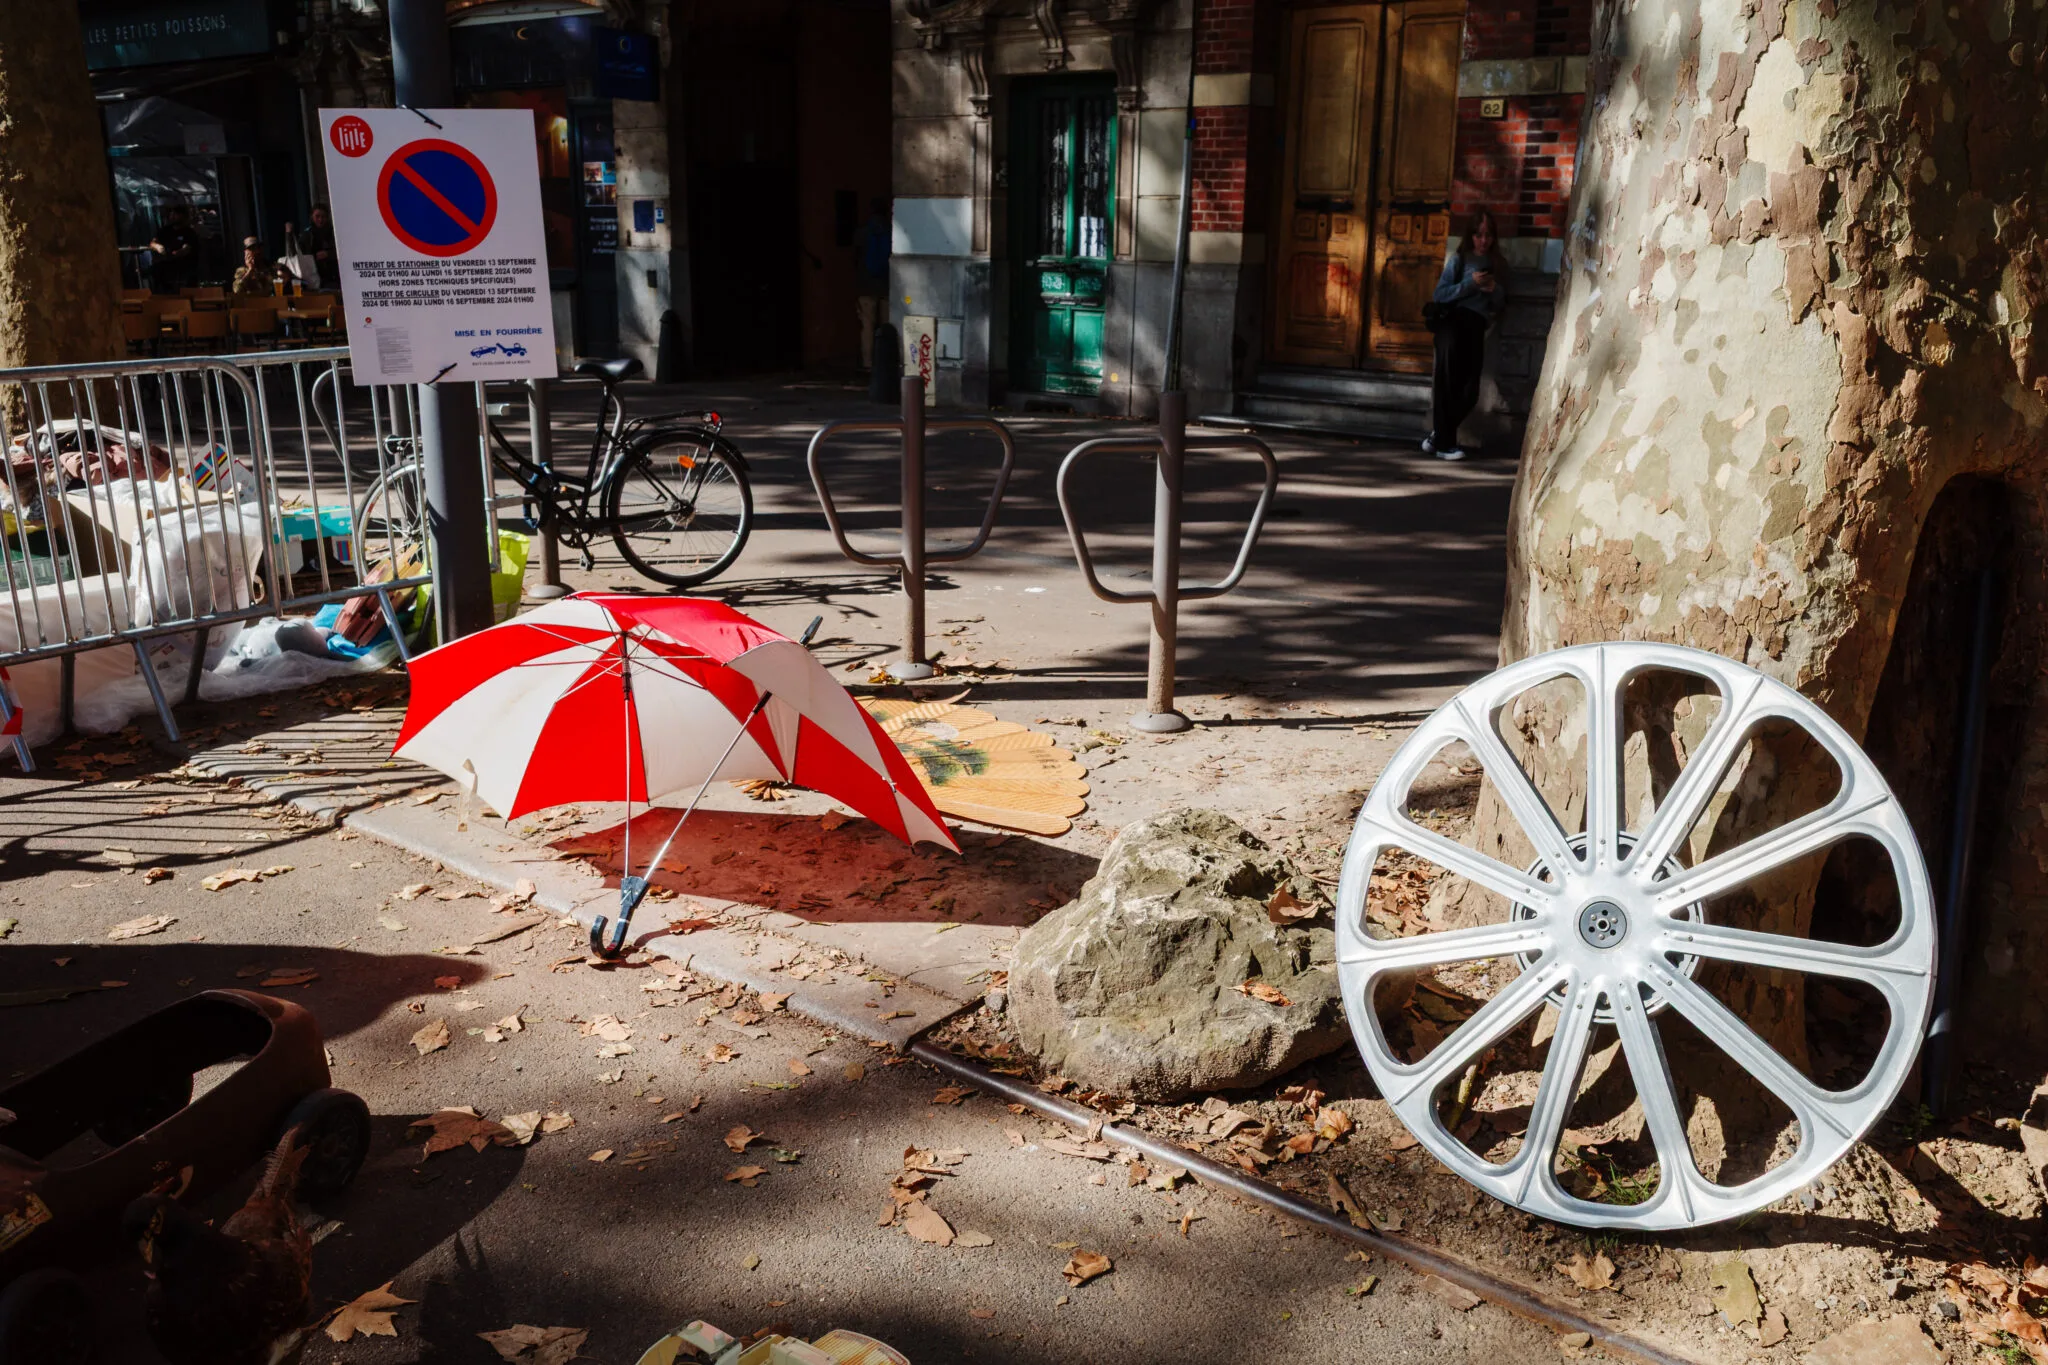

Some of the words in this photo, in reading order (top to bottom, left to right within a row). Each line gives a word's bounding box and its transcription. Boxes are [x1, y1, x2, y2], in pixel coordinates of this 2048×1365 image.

[88, 28, 108, 43] LES
[116, 21, 157, 40] PETITS
[1483, 103, 1500, 115] 62
[352, 261, 385, 269] INTERDIT
[397, 260, 440, 268] STATIONNER
[453, 259, 486, 267] VENDREDI
[498, 258, 537, 266] SEPTEMBRE
[454, 268, 493, 276] SEPTEMBRE
[495, 267, 511, 275] 2024
[512, 267, 533, 275] 05H00
[378, 279, 400, 288] (HORS
[426, 278, 469, 286] TECHNIQUES
[470, 276, 516, 285] SPÉCIFIQUES)
[362, 290, 393, 298] INTERDIT
[405, 290, 440, 298] CIRCULER
[453, 288, 486, 296] VENDREDI
[497, 287, 536, 295] SEPTEMBRE
[456, 297, 495, 305] SEPTEMBRE
[497, 296, 513, 304] 2024
[513, 296, 534, 304] 01H00
[496, 327, 543, 336] FOURRIÈRE
